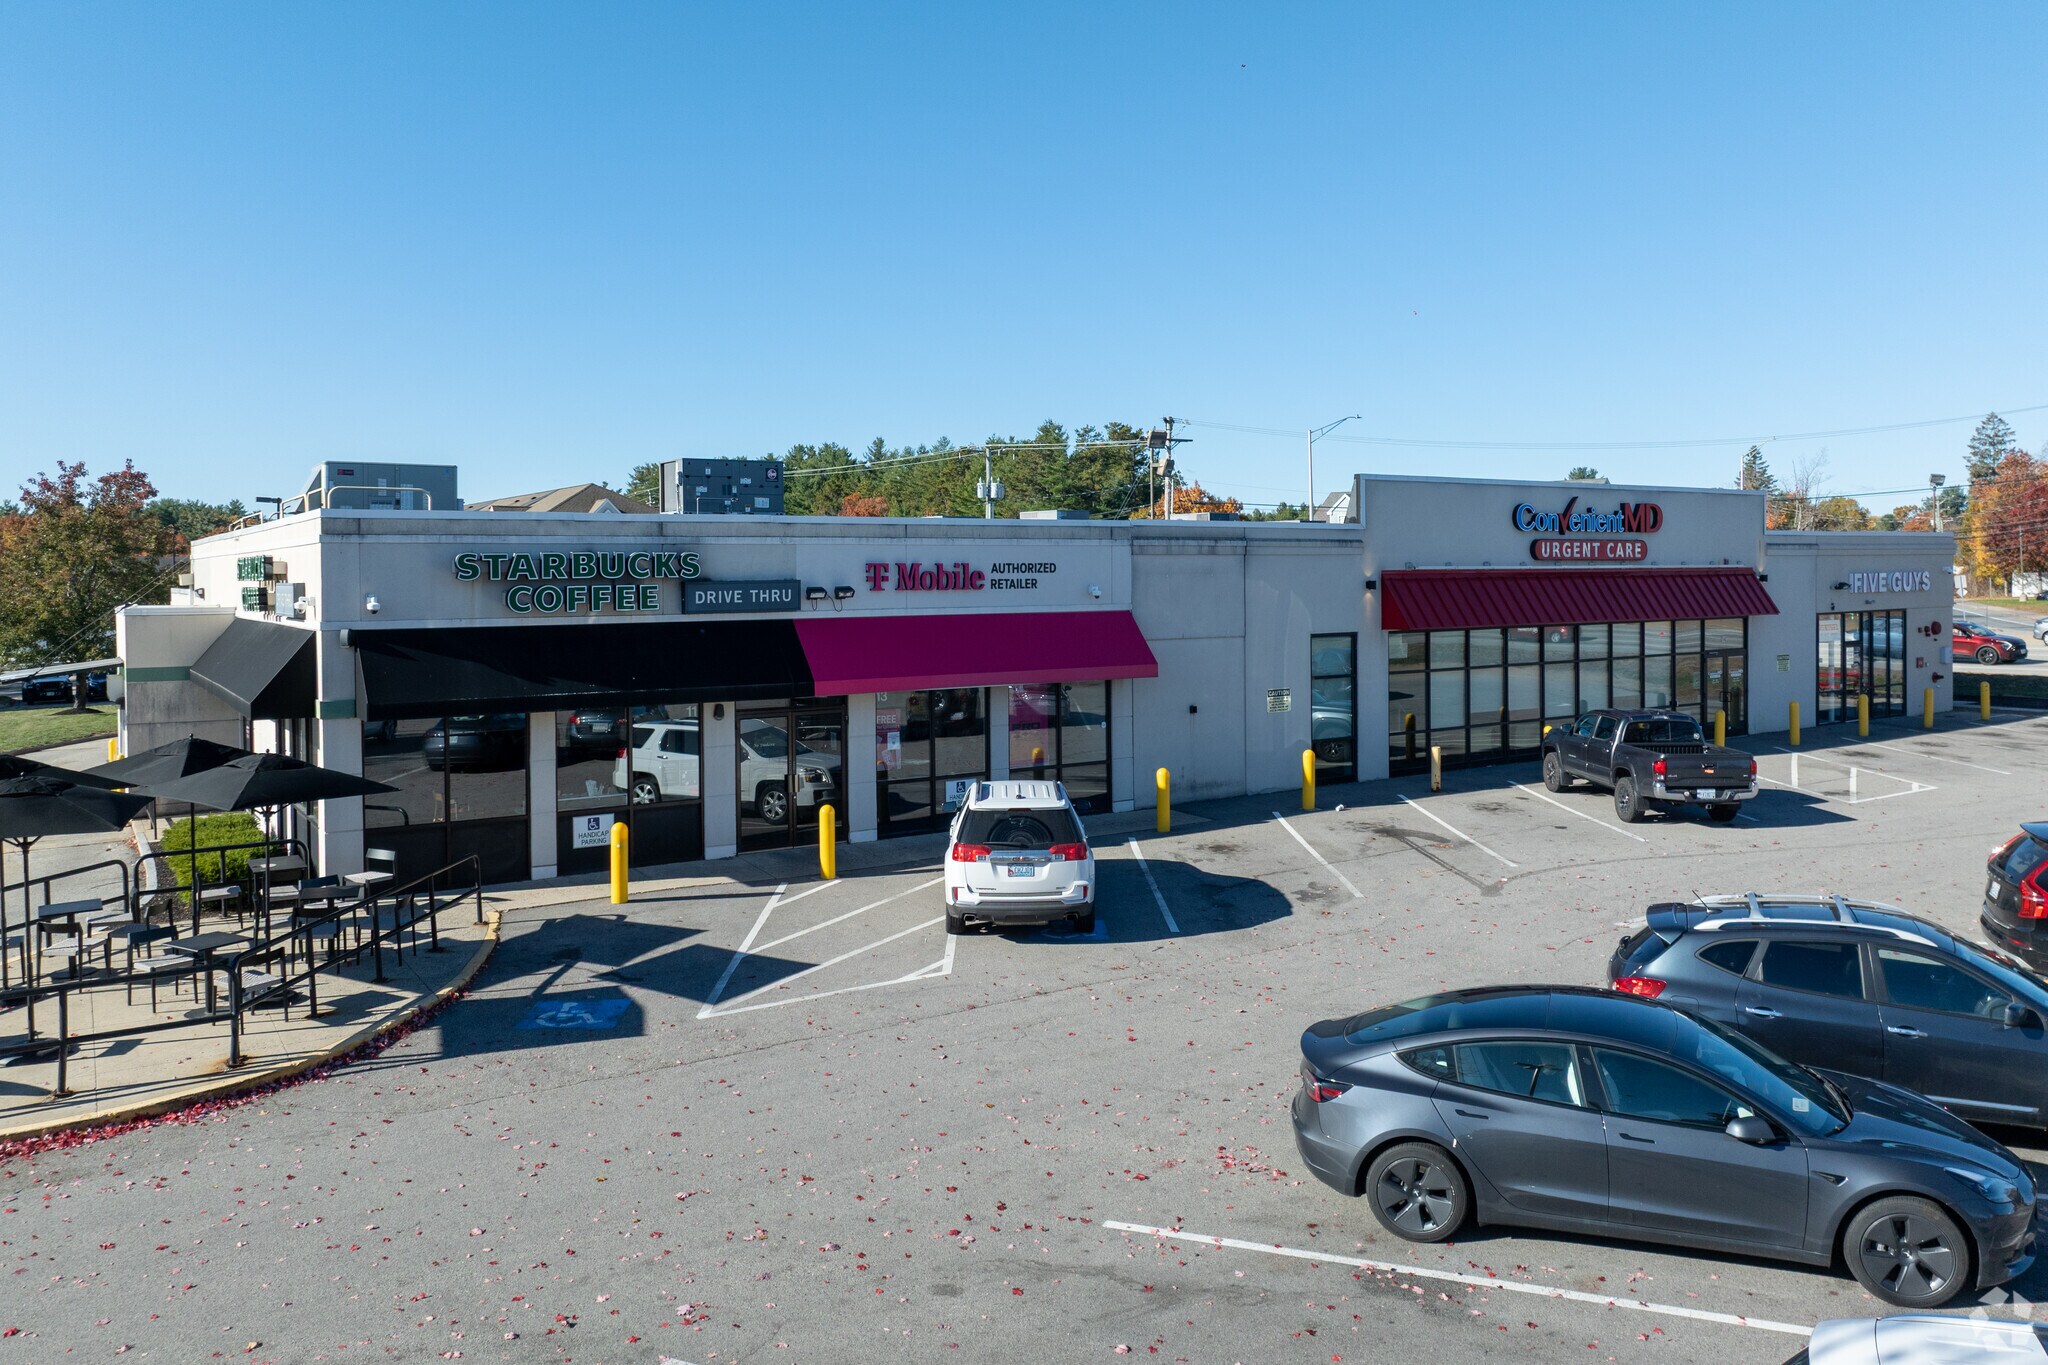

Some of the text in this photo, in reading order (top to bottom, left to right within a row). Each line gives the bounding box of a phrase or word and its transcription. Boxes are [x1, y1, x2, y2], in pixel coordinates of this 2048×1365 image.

[1541, 542, 1642, 558] URGENT CARE
[454, 551, 701, 581] STARBUCKS
[991, 563, 1056, 574] AUTHORIZED
[895, 562, 986, 591] Mobile
[1850, 571, 1931, 593] FIVE GUYS
[990, 578, 1038, 590] RETAILER
[506, 584, 660, 613] COFFEE
[695, 588, 793, 605] DRIVE THRU
[876, 691, 888, 701] 13
[1268, 689, 1290, 697] CAUTION
[686, 705, 698, 717] 11
[876, 714, 897, 724] FREE
[578, 830, 610, 839] HANDICAP
[581, 837, 607, 846] PARKING
